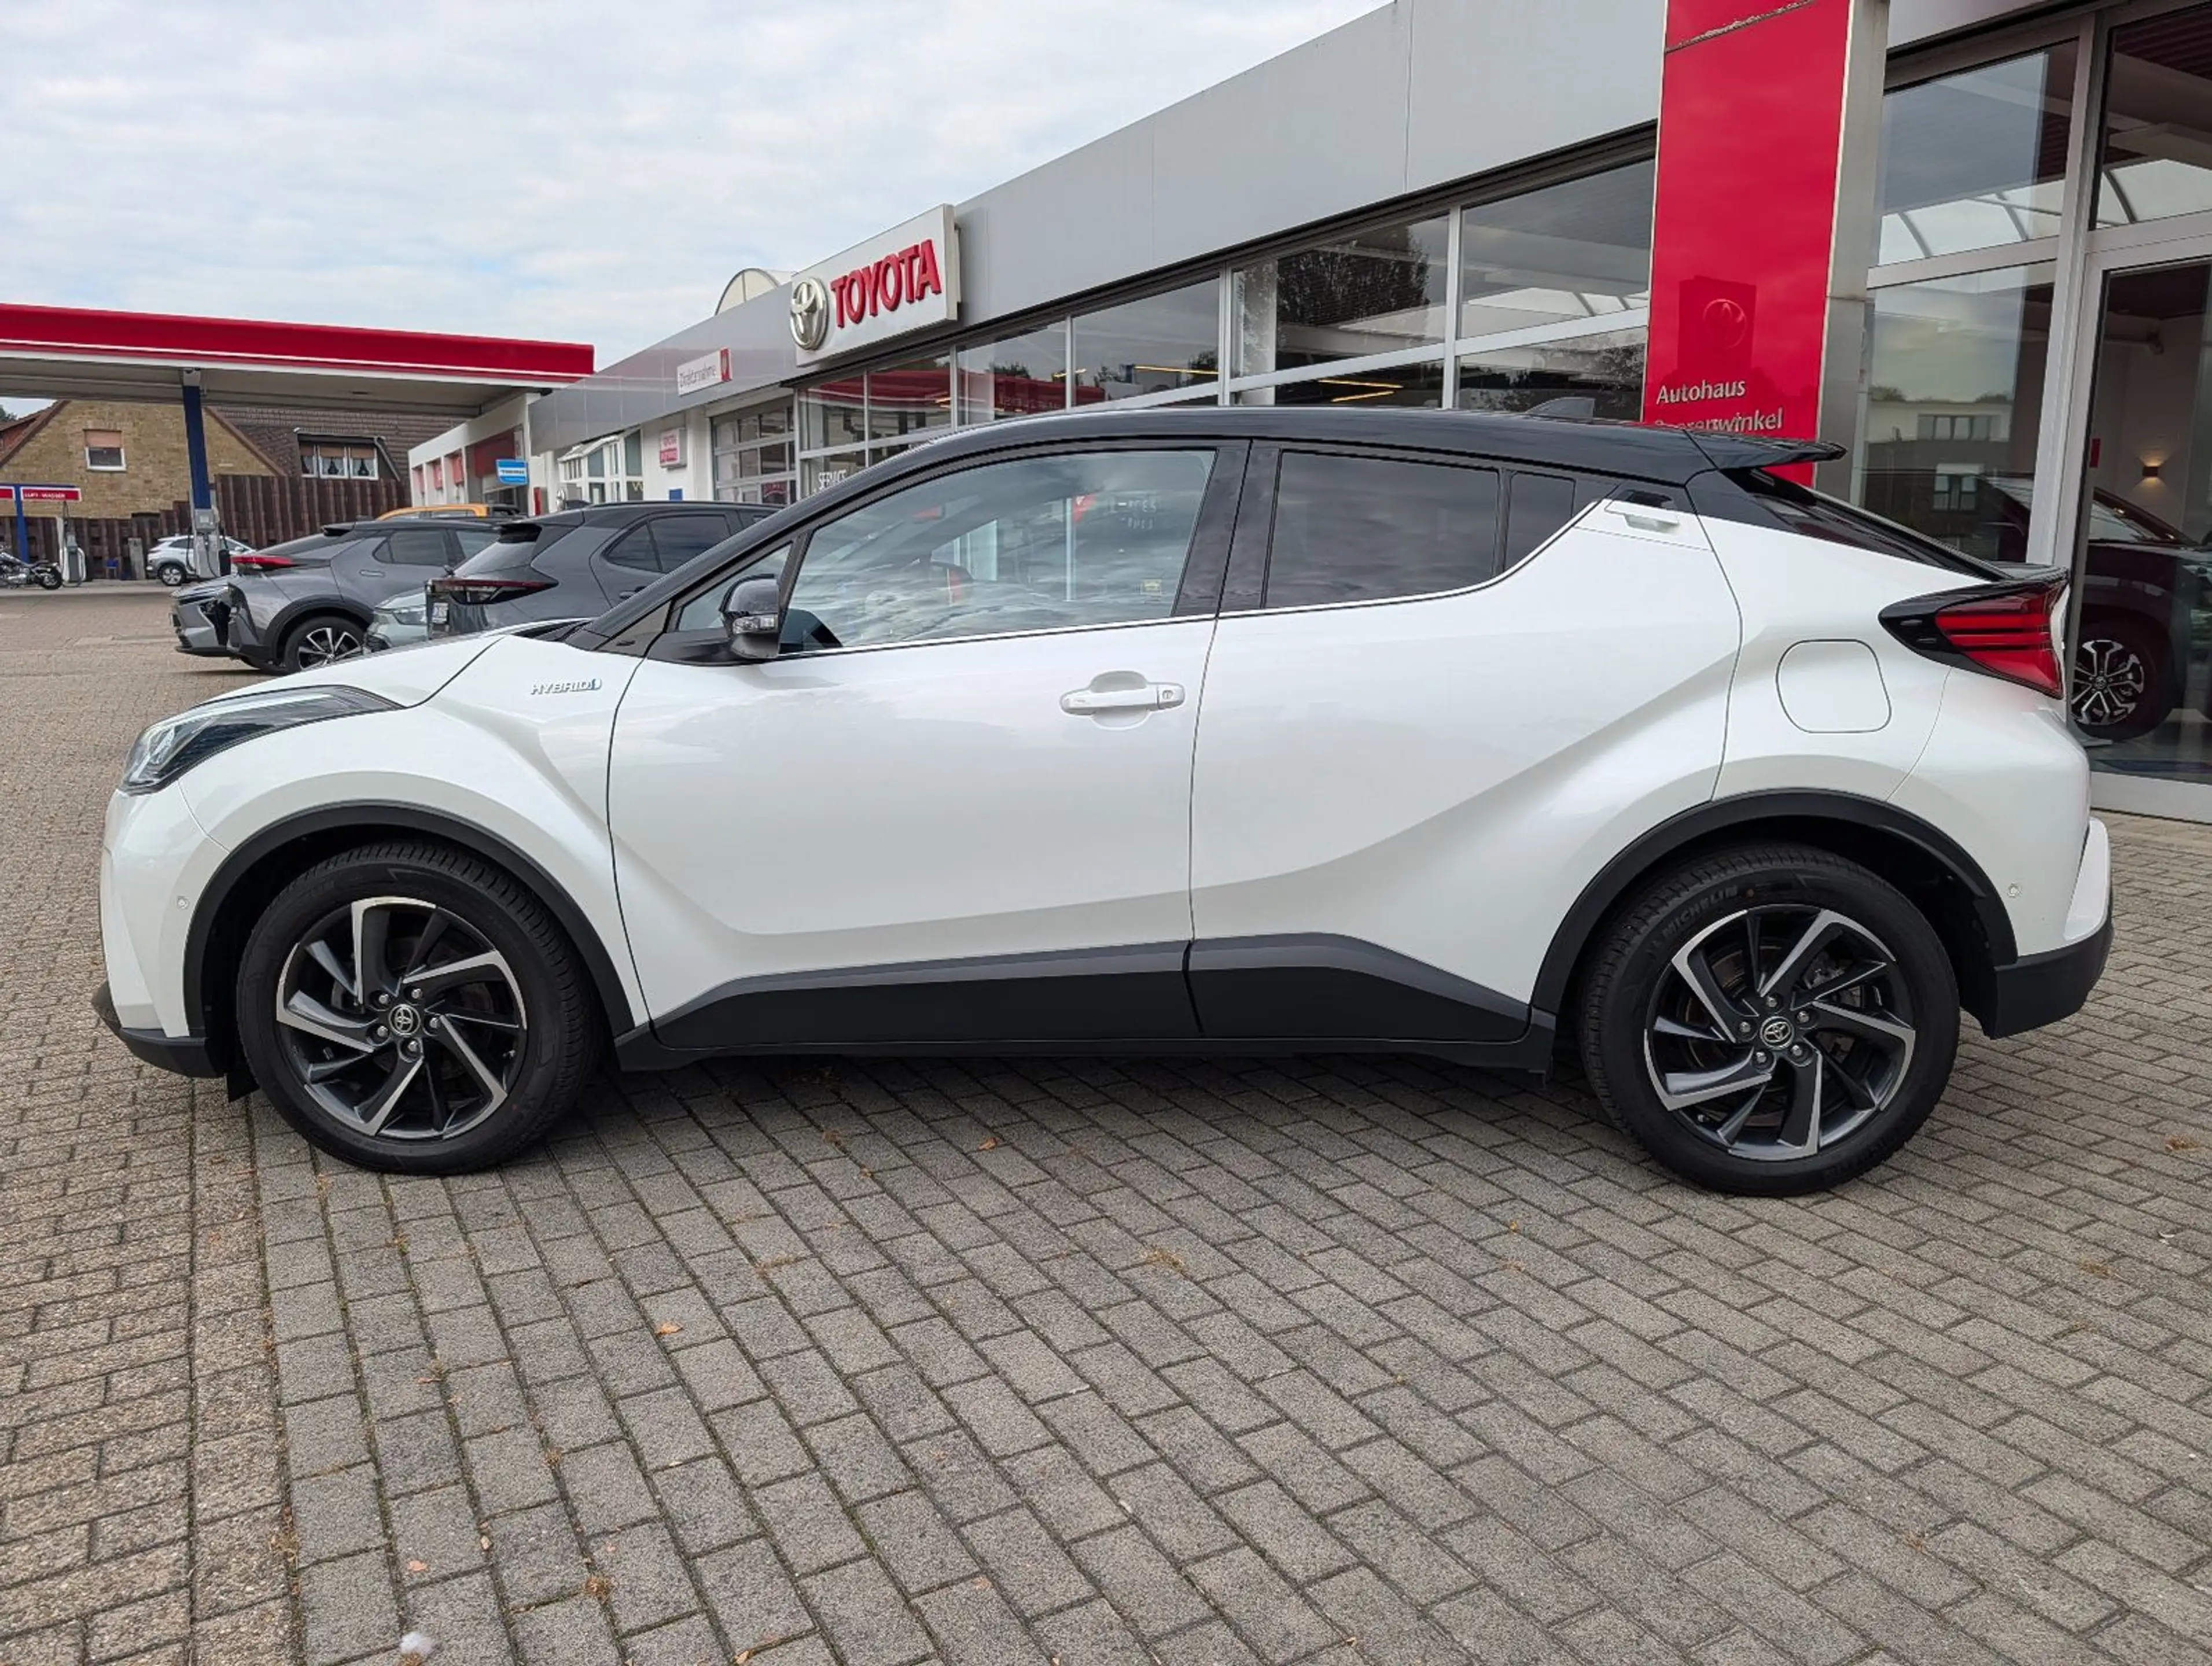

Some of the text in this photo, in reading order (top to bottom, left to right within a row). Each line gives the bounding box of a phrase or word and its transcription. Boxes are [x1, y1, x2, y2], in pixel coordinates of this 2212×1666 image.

[830, 238, 942, 329] TOYOTA
[1657, 379, 1746, 404] Autohaus
[1655, 407, 1783, 432] renwinkel
[530, 680, 593, 695] HYBRID
